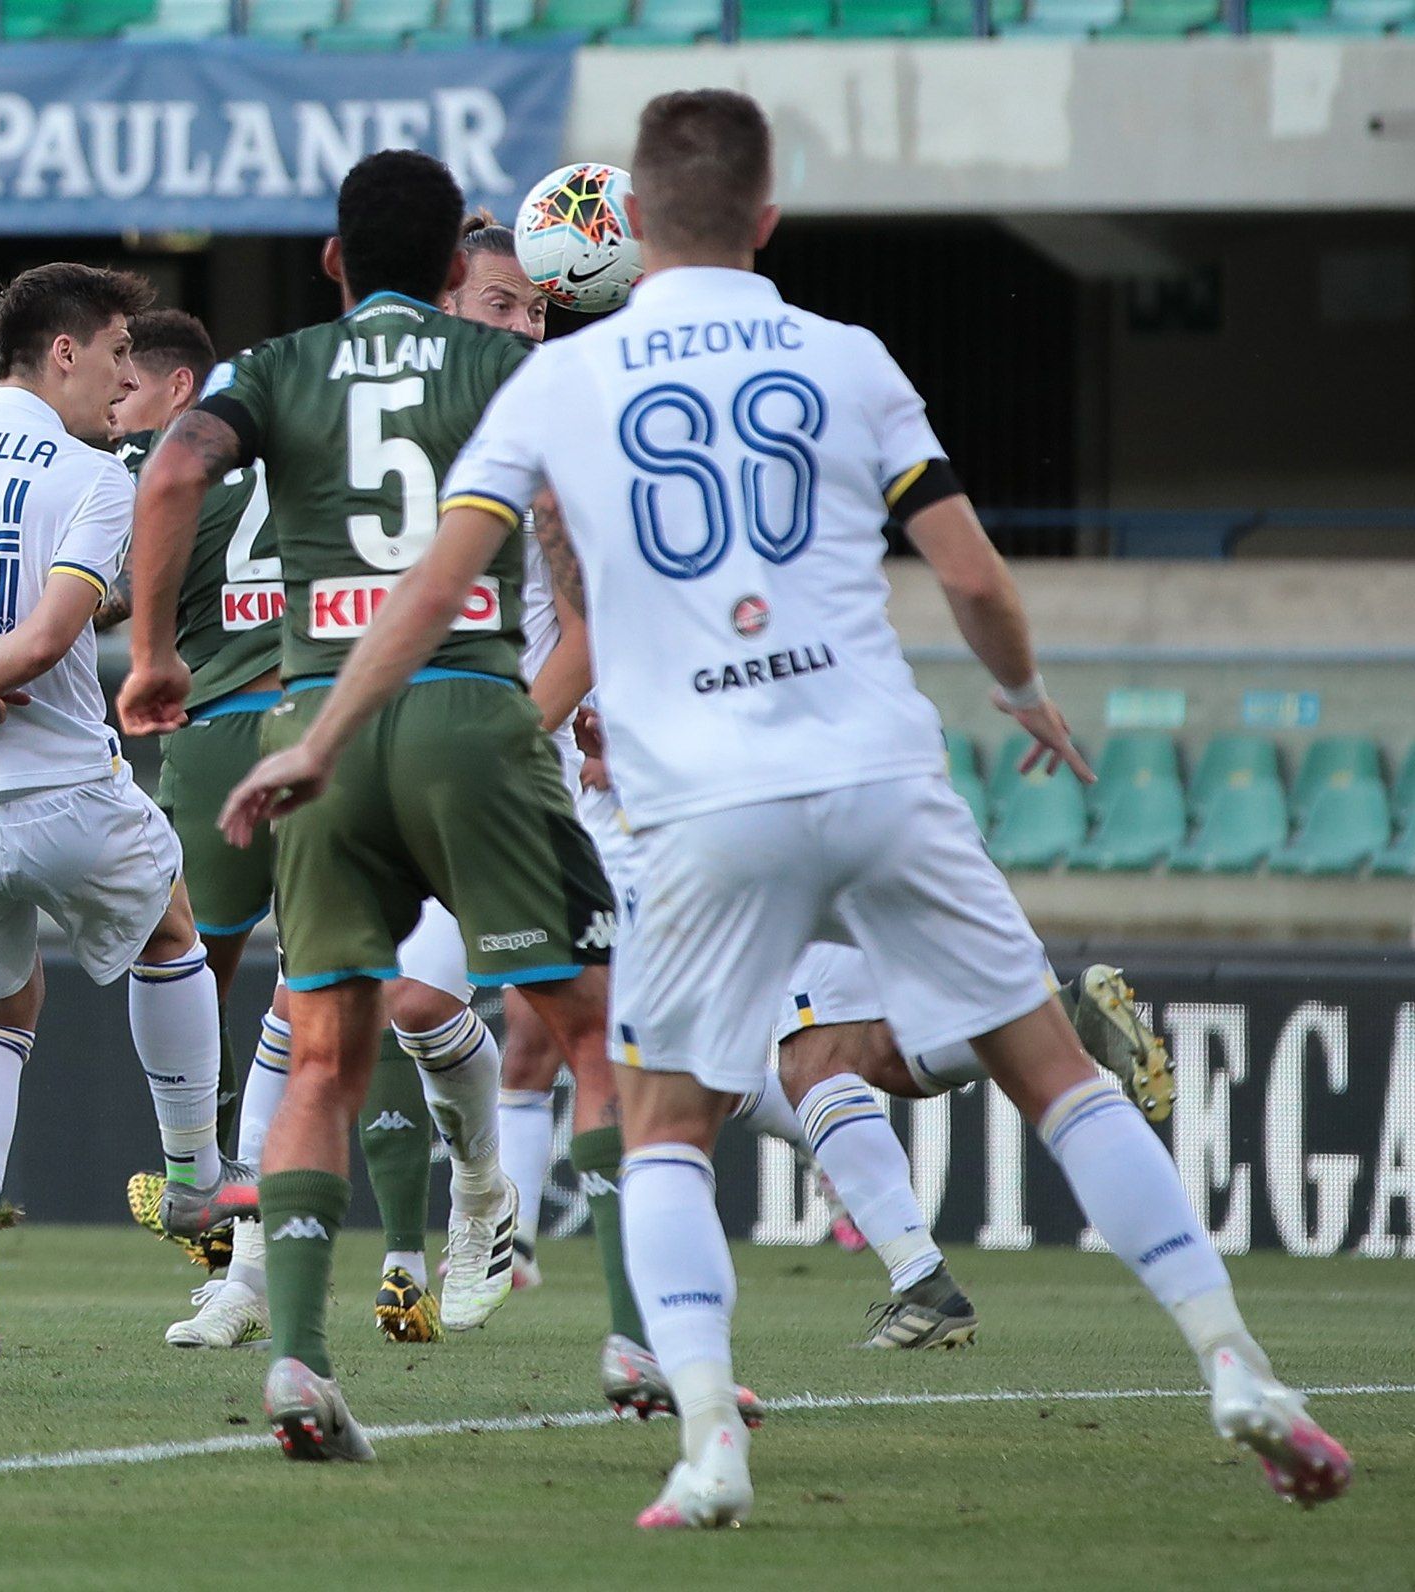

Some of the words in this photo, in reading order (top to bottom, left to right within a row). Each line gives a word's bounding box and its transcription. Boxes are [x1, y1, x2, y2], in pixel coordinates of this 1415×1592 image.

[328, 334, 447, 380] ALLAN
[620, 316, 805, 372] LAZOVIĆ
[347, 376, 439, 571] 5
[619, 368, 829, 581] 88
[315, 586, 498, 628] KIO
[693, 642, 839, 695] GARELLI
[481, 929, 548, 952] Kappa
